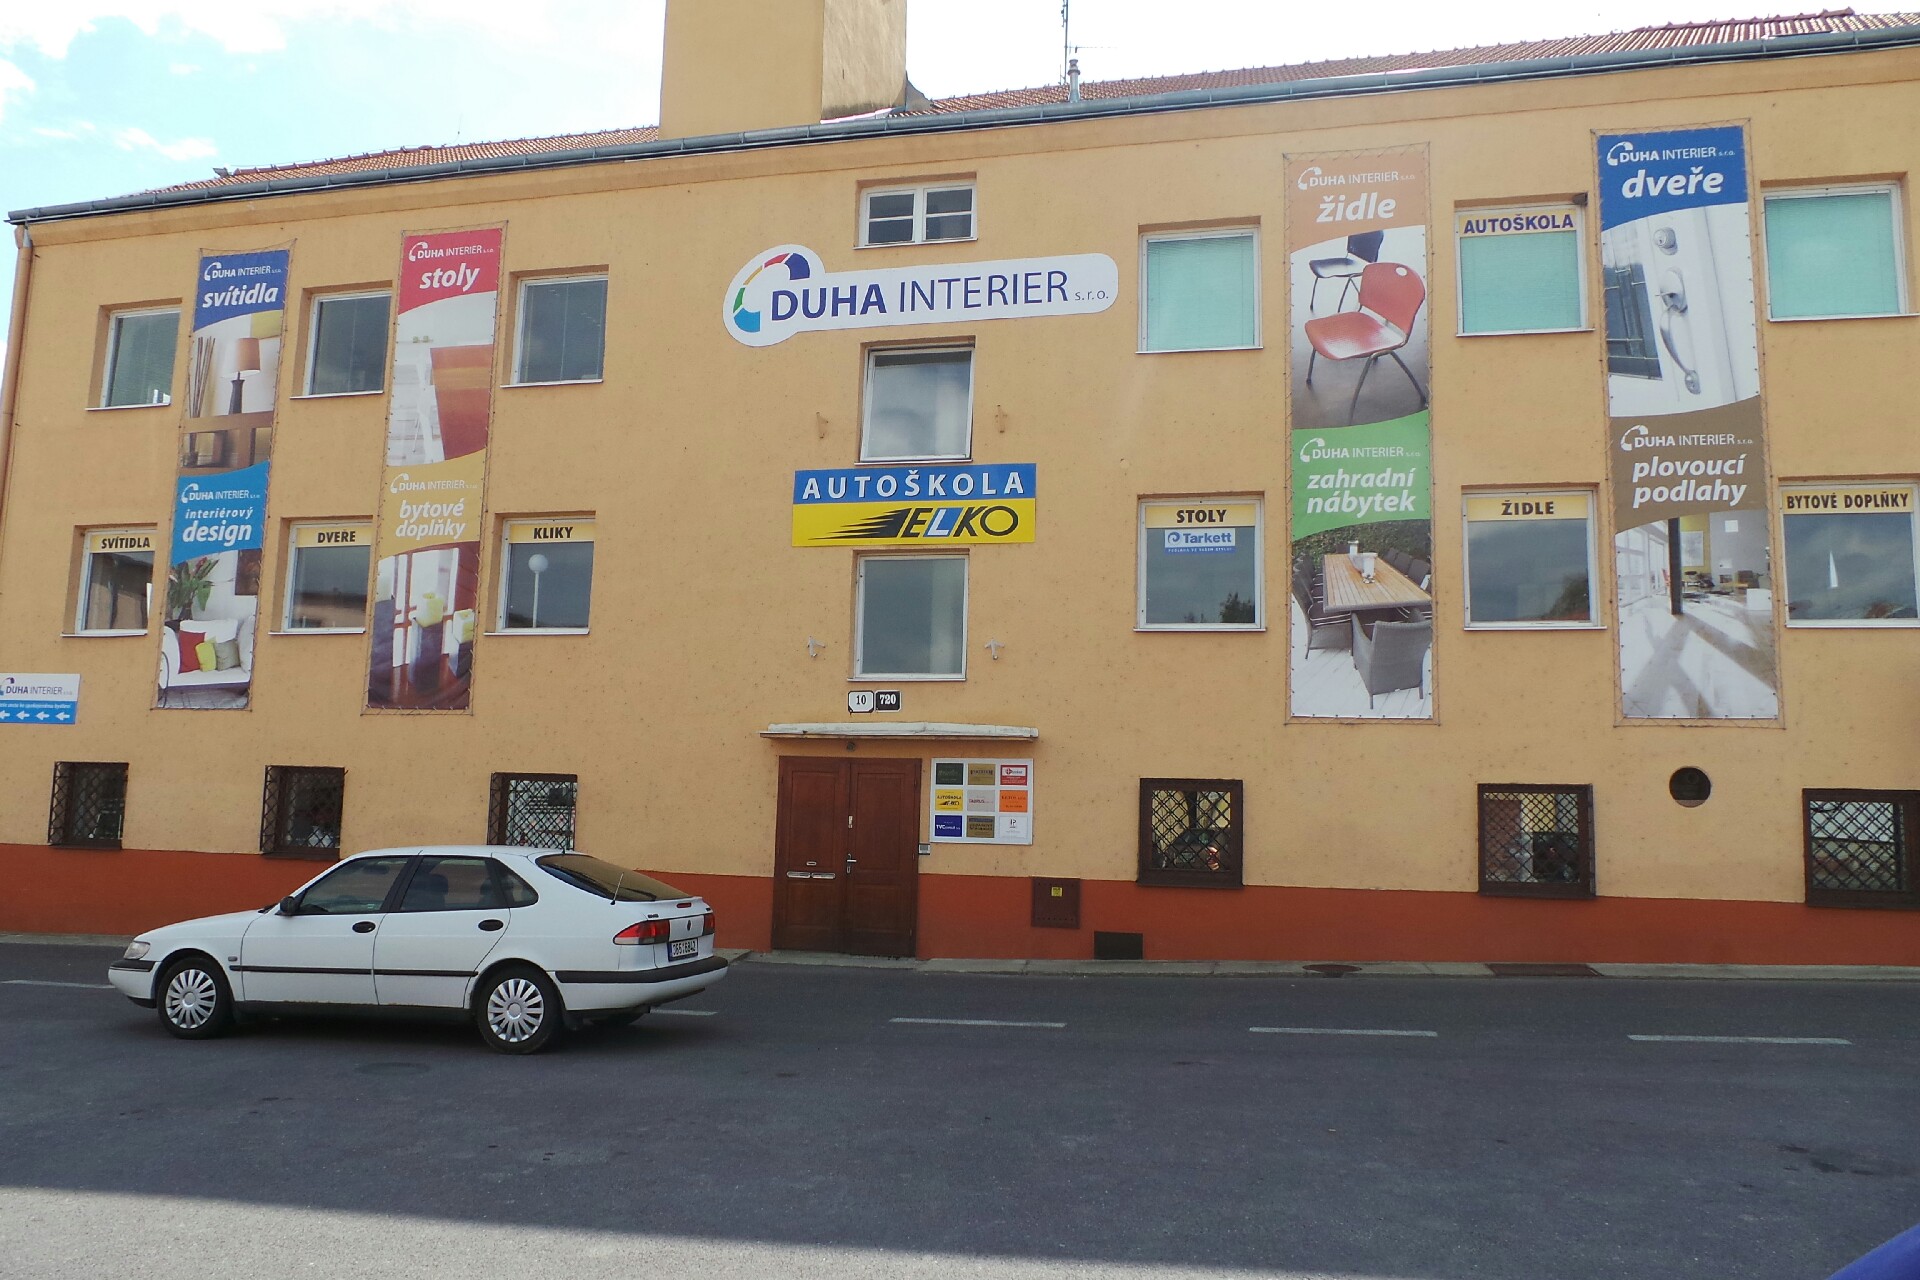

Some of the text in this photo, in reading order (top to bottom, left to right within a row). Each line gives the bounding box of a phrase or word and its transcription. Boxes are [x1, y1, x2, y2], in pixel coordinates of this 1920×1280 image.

[1620, 150, 1660, 163] DUHA
[1662, 147, 1716, 160] INTERIER
[1310, 176, 1346, 187] DUHA
[1348, 171, 1399, 184] INTERIER
[1621, 166, 1724, 198] dveře
[1316, 192, 1396, 223] židle
[1464, 214, 1574, 234] AUTOŠKOLA
[417, 249, 444, 259] DUHA
[446, 244, 483, 256] INTERIER
[212, 269, 236, 278] DUHA
[237, 266, 271, 277] INTERIER
[420, 262, 480, 292] stoly
[202, 282, 279, 308] svítidla
[771, 270, 1110, 322] DUHA INTERIER s.r.o.
[1634, 435, 1676, 448] DUHA
[1678, 434, 1735, 446] INTERIER
[1312, 448, 1349, 459] DUHA
[1352, 446, 1404, 458] INTERIER
[1632, 453, 1747, 483] plovoucí
[399, 482, 426, 491] DUHA
[428, 480, 465, 490] INTERIER
[802, 469, 1025, 500] AUTOŠKOLA
[1307, 468, 1416, 489] zahradní
[189, 492, 214, 500] DUHA
[215, 490, 249, 499] INTERIER
[1632, 479, 1747, 508] podlahy
[1787, 491, 1908, 509] BYTOVÉ DOPLŇKY
[400, 498, 465, 523] bytové
[1306, 490, 1416, 518] nábytek
[1501, 500, 1554, 515] ŽIDLE
[185, 507, 253, 519] interiérový
[1176, 509, 1227, 523] STOLY
[395, 519, 466, 540] doplňky
[900, 505, 1019, 538] ELKO
[182, 520, 252, 547] design
[317, 529, 356, 543] DVEŘE
[534, 527, 574, 539] KLIKY
[1183, 533, 1231, 543] Tarkett
[101, 536, 150, 549] SVÍTIDLA
[6, 686, 28, 694] DUHA
[30, 686, 63, 695] INTERIER
[856, 695, 866, 705] 10
[880, 694, 896, 705] 720
